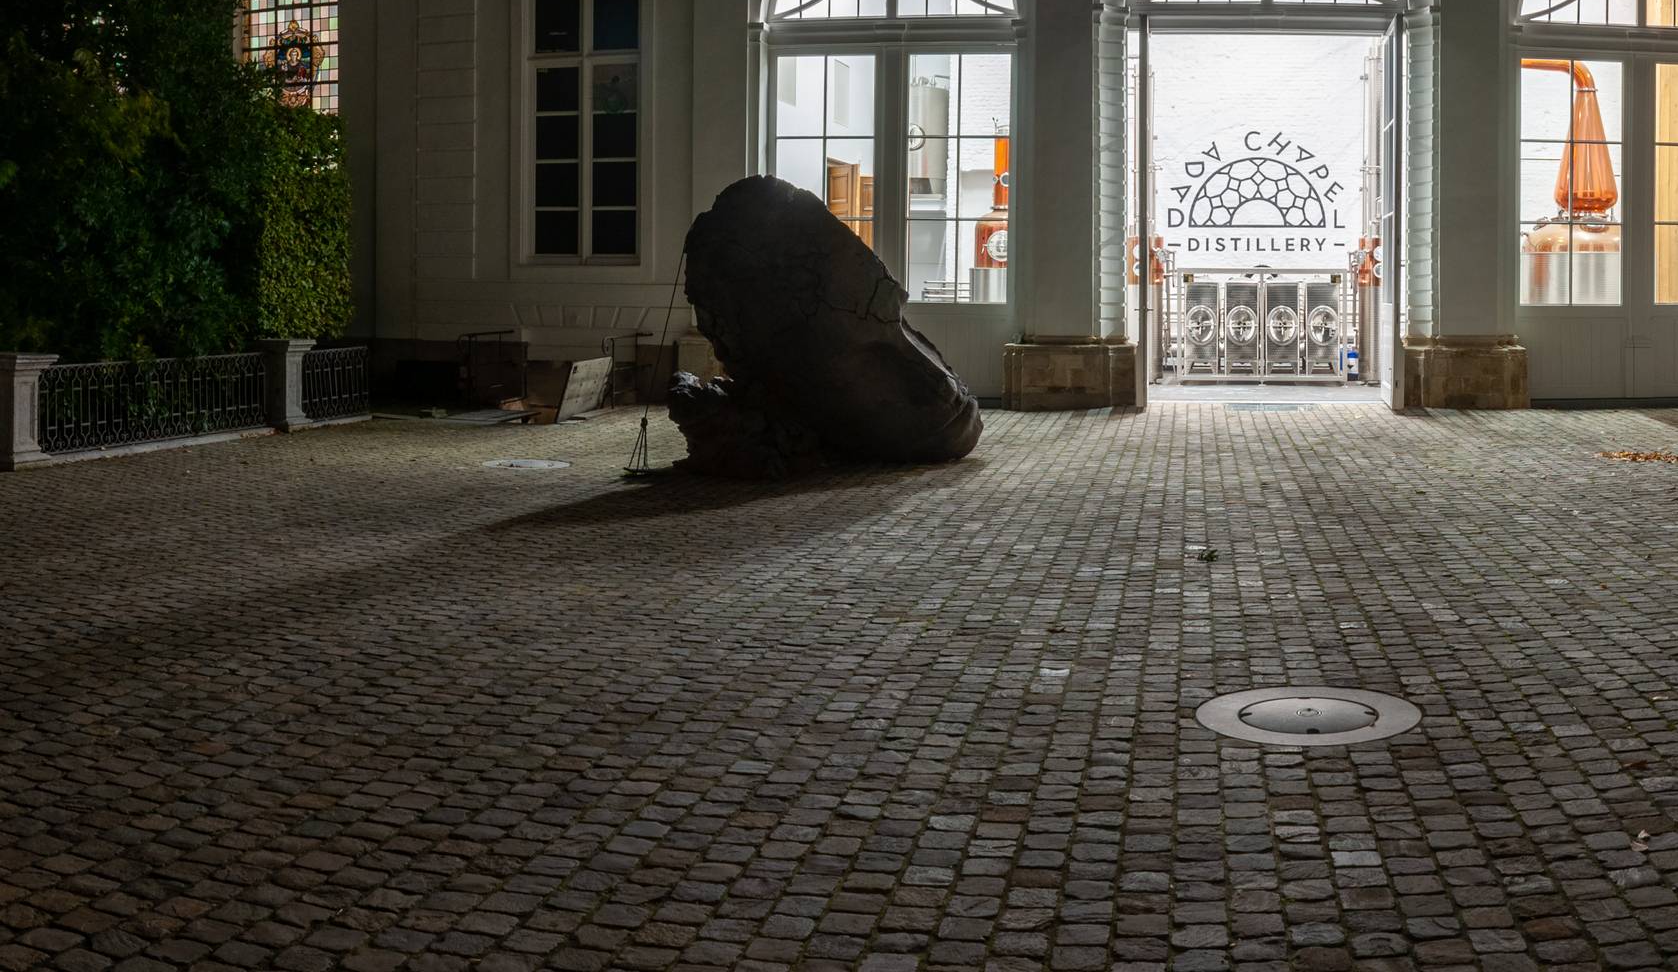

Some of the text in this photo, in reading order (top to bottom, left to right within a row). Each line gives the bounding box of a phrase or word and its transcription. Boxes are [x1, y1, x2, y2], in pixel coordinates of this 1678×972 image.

[1167, 131, 1346, 228] DADA CHAPEL
[1187, 237, 1327, 252] DISTILLERY
